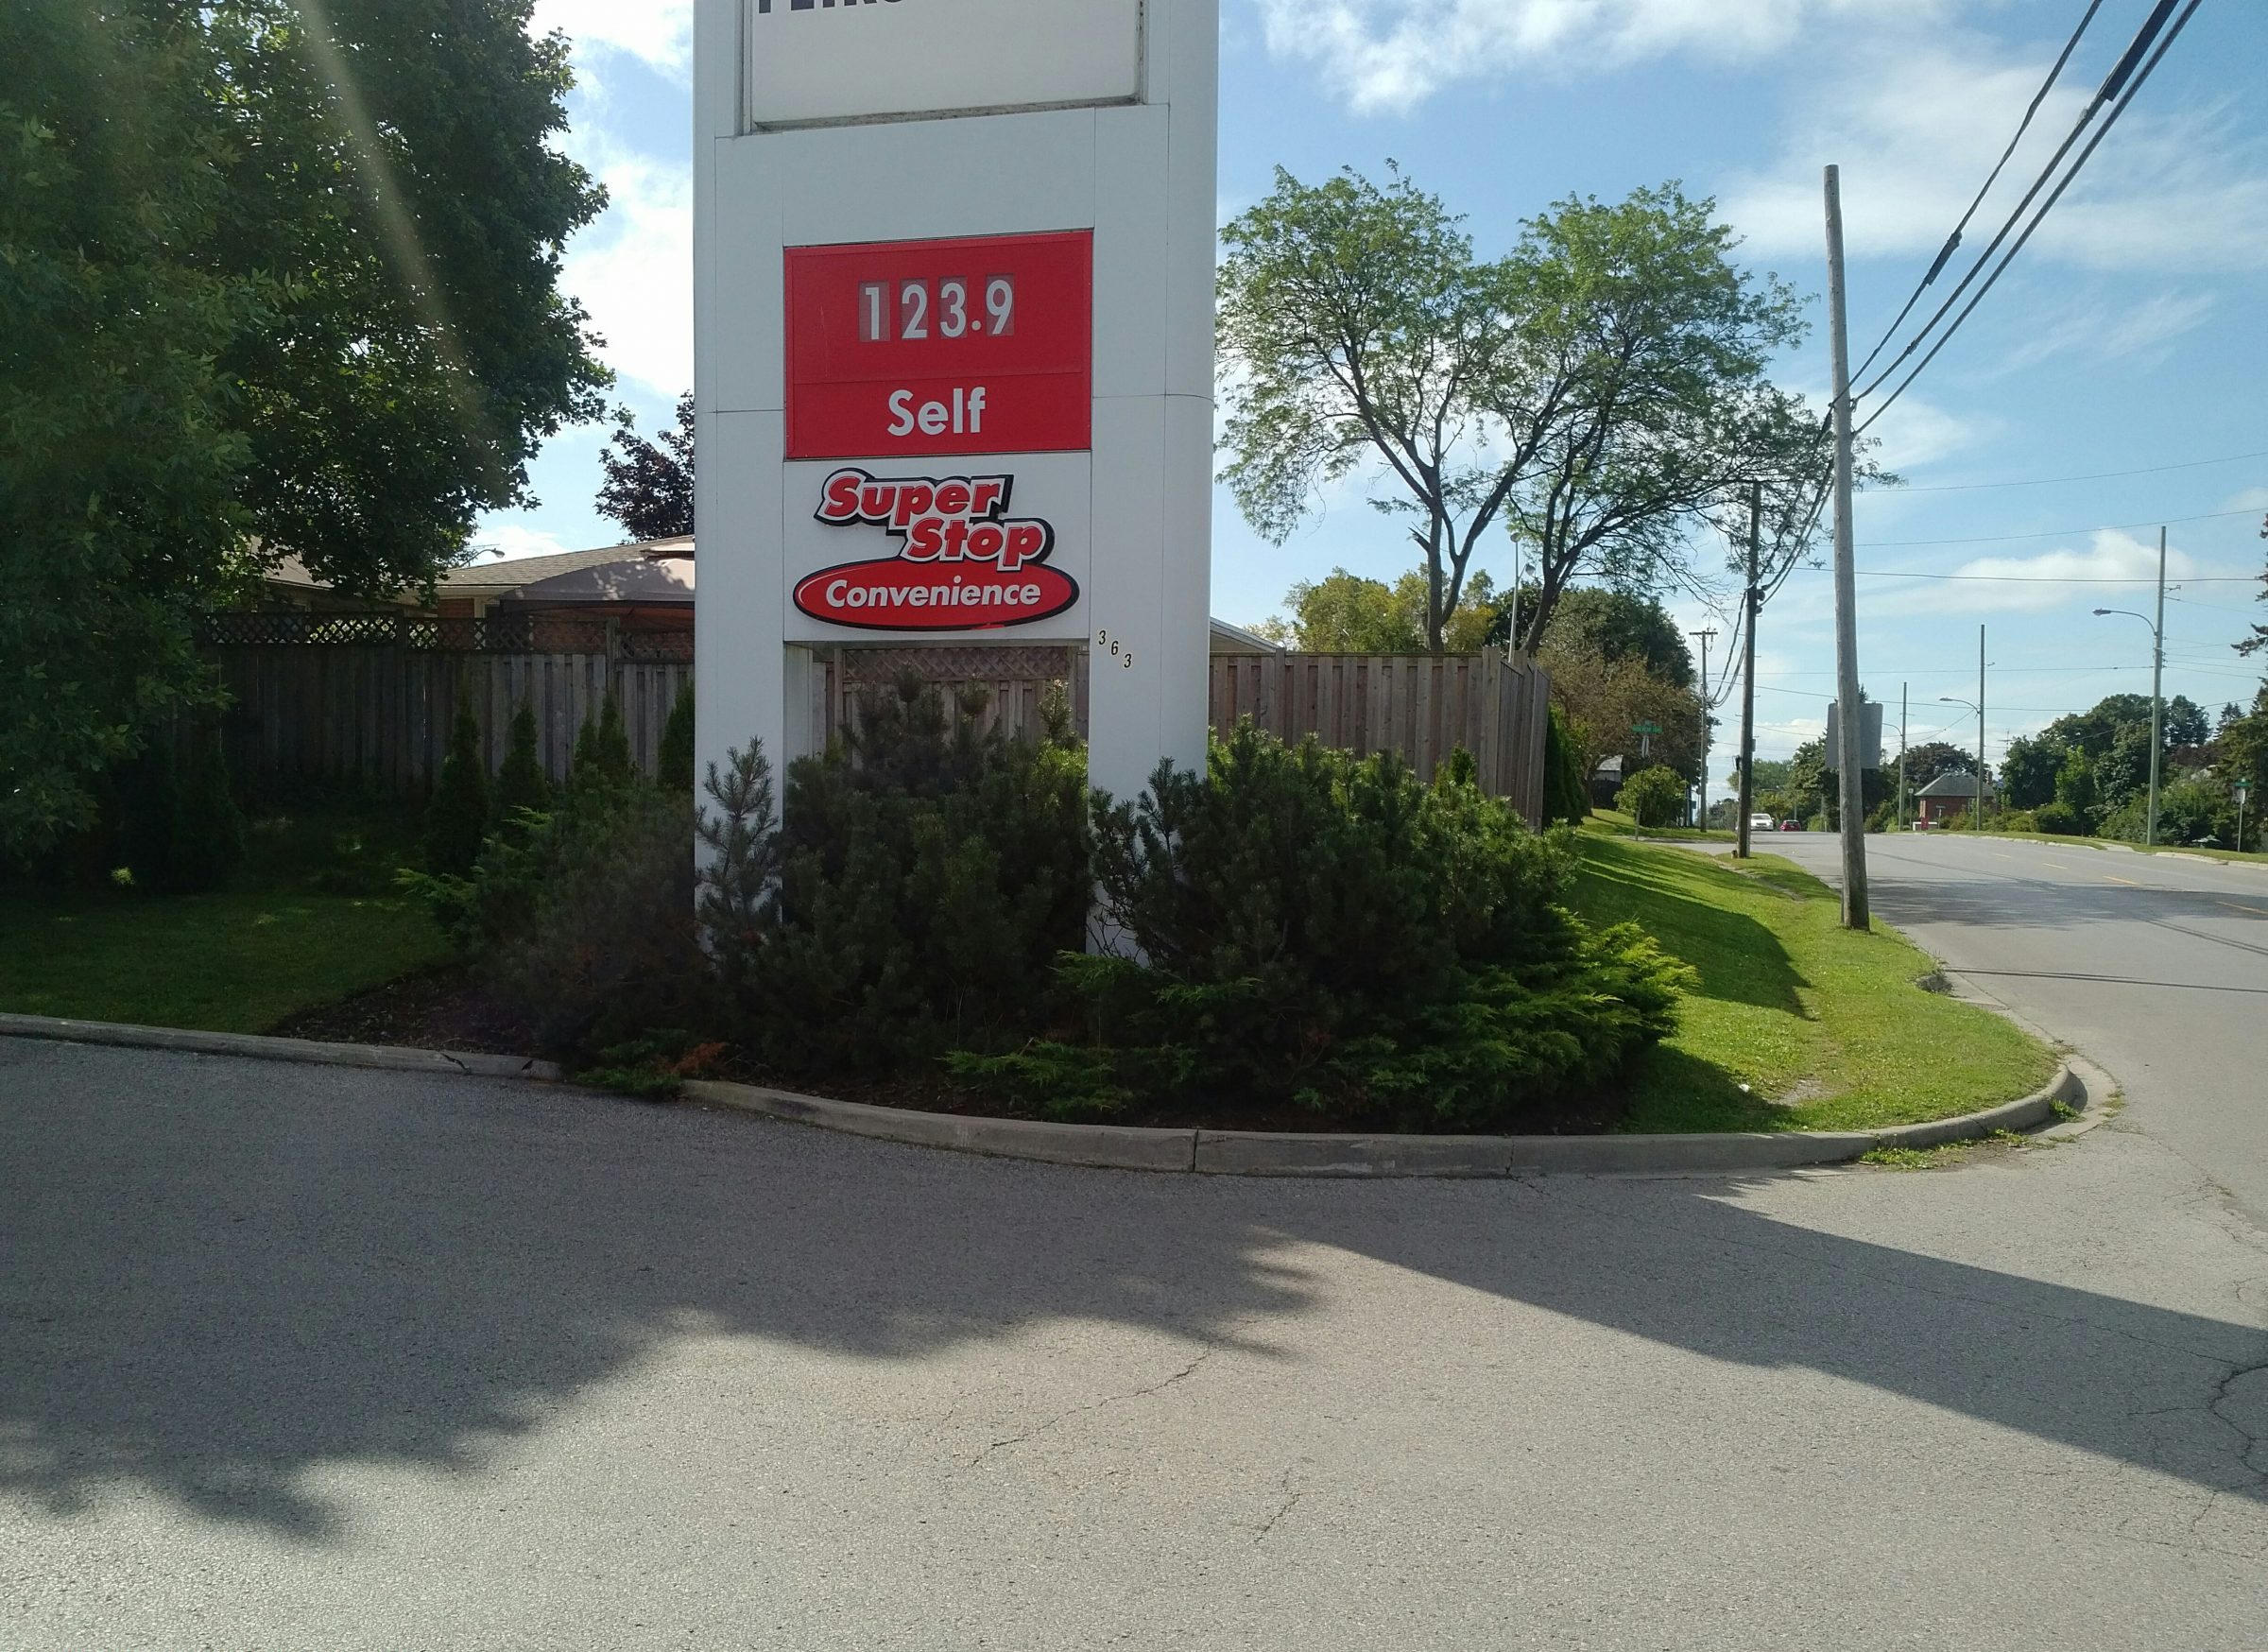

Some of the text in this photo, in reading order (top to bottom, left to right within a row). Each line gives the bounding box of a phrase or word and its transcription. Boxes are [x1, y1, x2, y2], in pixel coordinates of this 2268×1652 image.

[866, 279, 1013, 340] 123.9
[887, 387, 986, 437] Self
[824, 475, 1001, 526] Super
[907, 517, 1043, 567] Stop
[825, 575, 1041, 608] Convenience
[1098, 629, 1132, 668] 363
